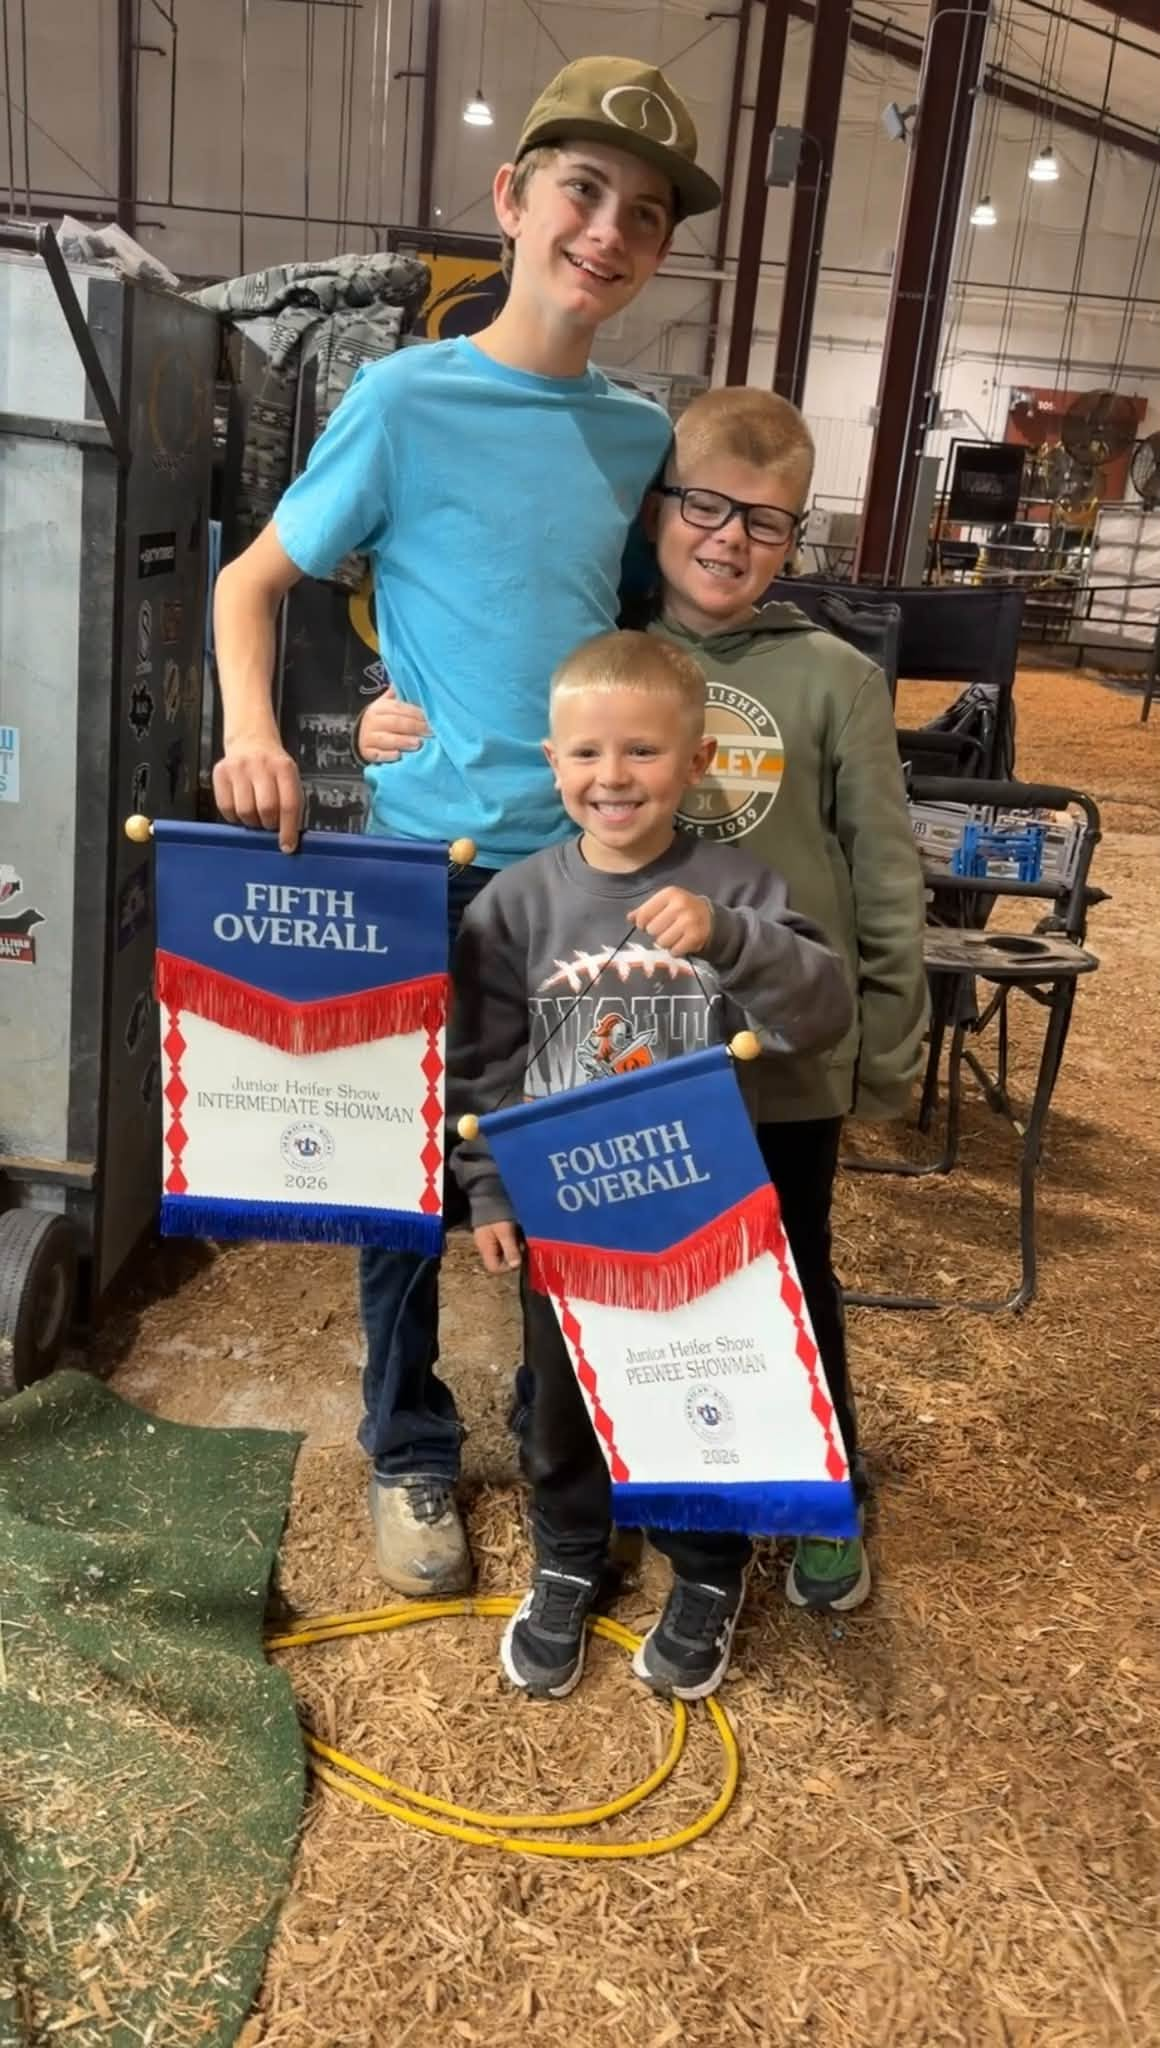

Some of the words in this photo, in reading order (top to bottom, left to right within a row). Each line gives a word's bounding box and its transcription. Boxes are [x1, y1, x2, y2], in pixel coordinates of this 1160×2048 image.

[709, 687, 768, 728] LISHED
[708, 748, 767, 778] LEY
[717, 808, 757, 836] 1999
[245, 882, 355, 919] FIFTH
[213, 913, 388, 954] OVERALL
[231, 1076, 279, 1094] Junior
[285, 1080, 332, 1098] Heifer
[337, 1083, 381, 1101] Show
[197, 1091, 320, 1116] INTERMEDIATE
[324, 1101, 415, 1124] SHOWMAN
[548, 1120, 691, 1182] FOURTH
[284, 1174, 328, 1191] 2026
[557, 1154, 711, 1212] OVERALL
[626, 1347, 666, 1364] Junior
[669, 1338, 712, 1359] Heifer
[715, 1335, 756, 1352] Show
[625, 1362, 685, 1386] PEEWEE
[687, 1353, 768, 1379] SHOWMAN
